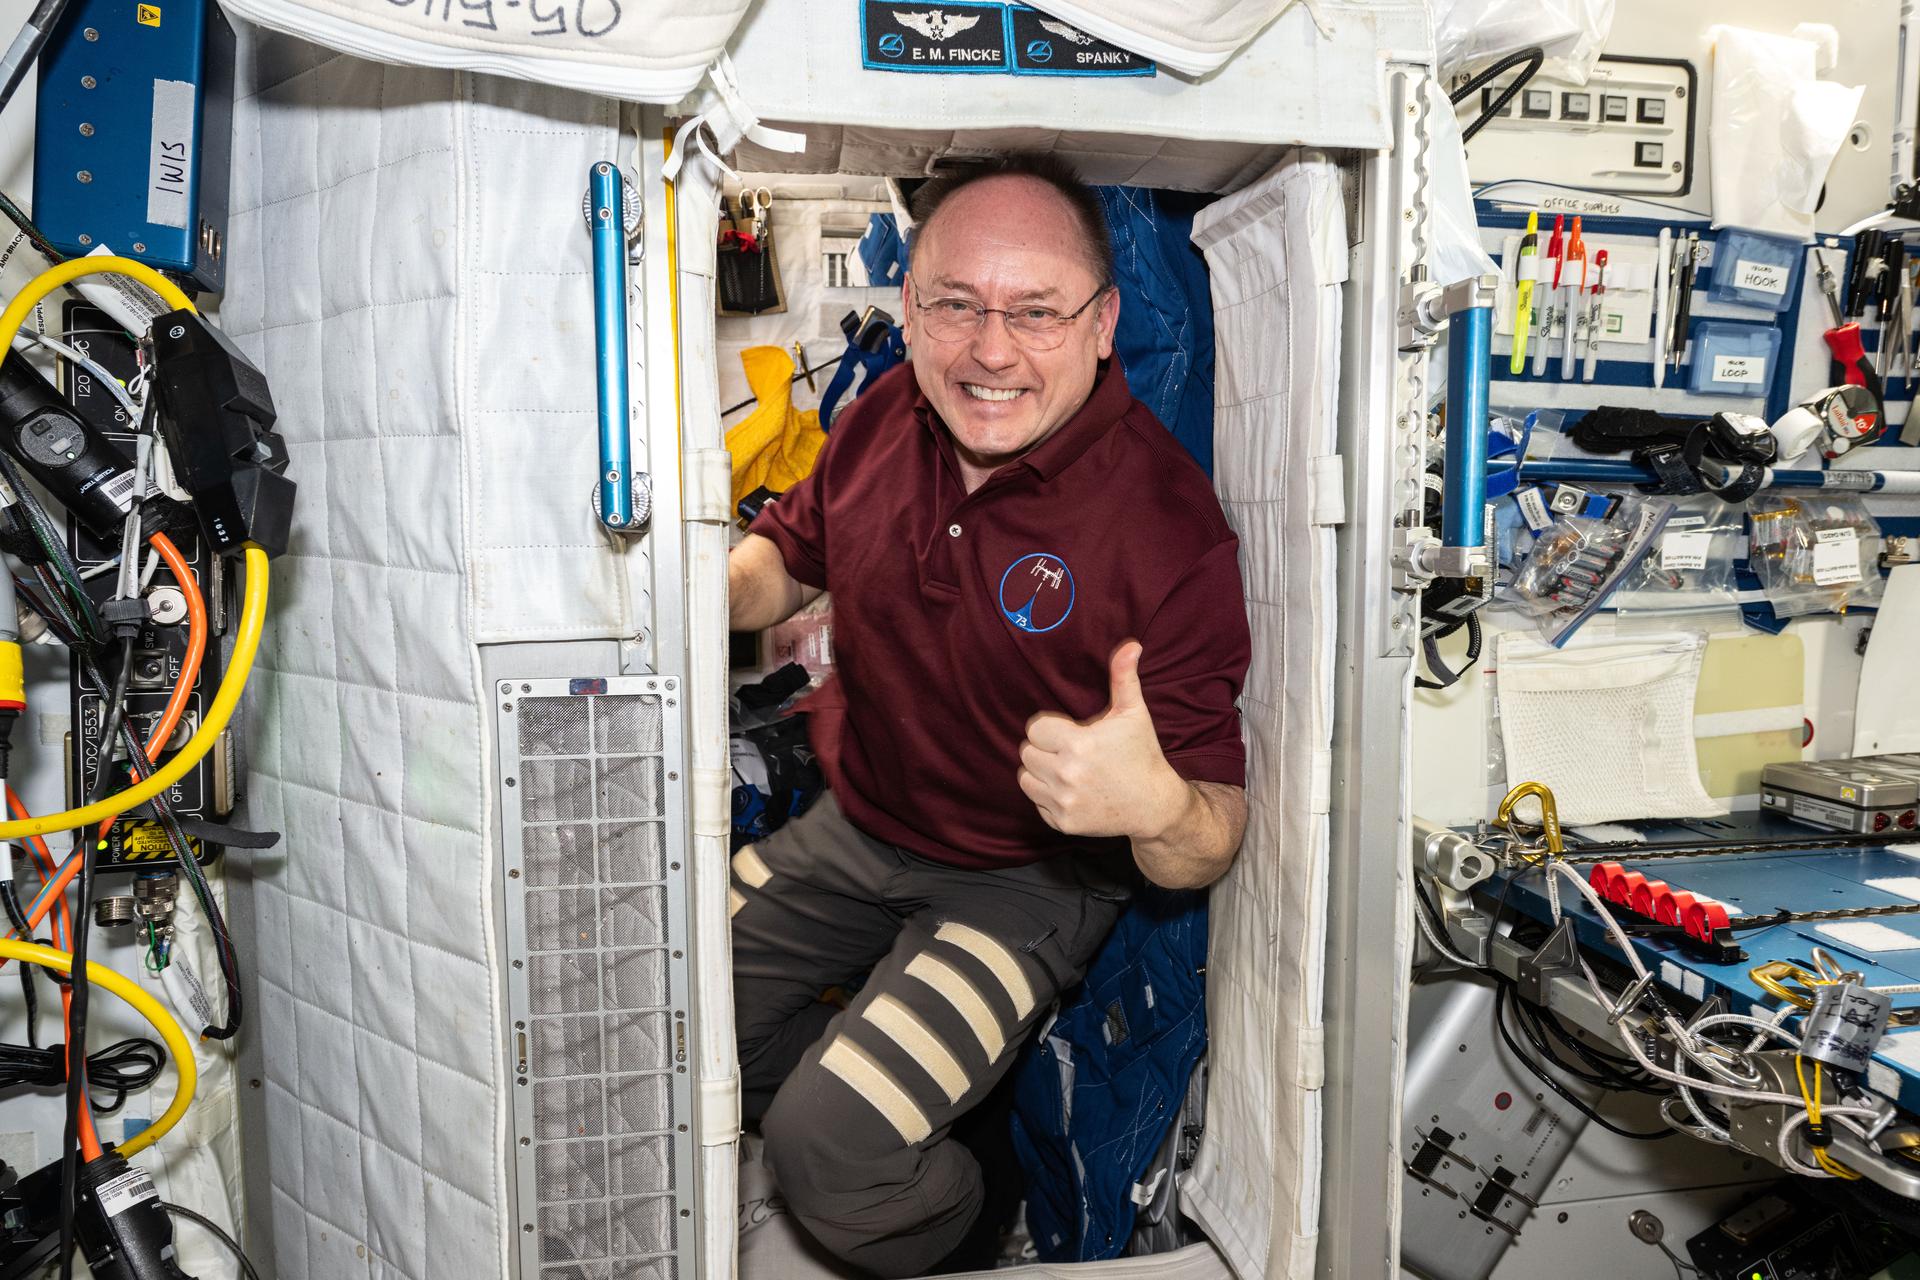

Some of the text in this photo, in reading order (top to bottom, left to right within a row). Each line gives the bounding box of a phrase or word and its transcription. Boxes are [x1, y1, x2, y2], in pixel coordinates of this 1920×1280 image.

[912, 47, 1001, 62] E. M. FINCKE
[1076, 50, 1132, 64] SPANKY
[1544, 198, 1579, 210] OFFICE
[1744, 273, 1779, 287] HOOK
[1721, 367, 1748, 378] LOOP
[77, 374, 91, 398] 120
[114, 405, 126, 422] ON
[1015, 614, 1030, 627] 73
[145, 631, 154, 649] SW2
[169, 656, 180, 679] OFF
[85, 708, 98, 775] VDC/1553
[111, 822, 121, 863] POWER ON
